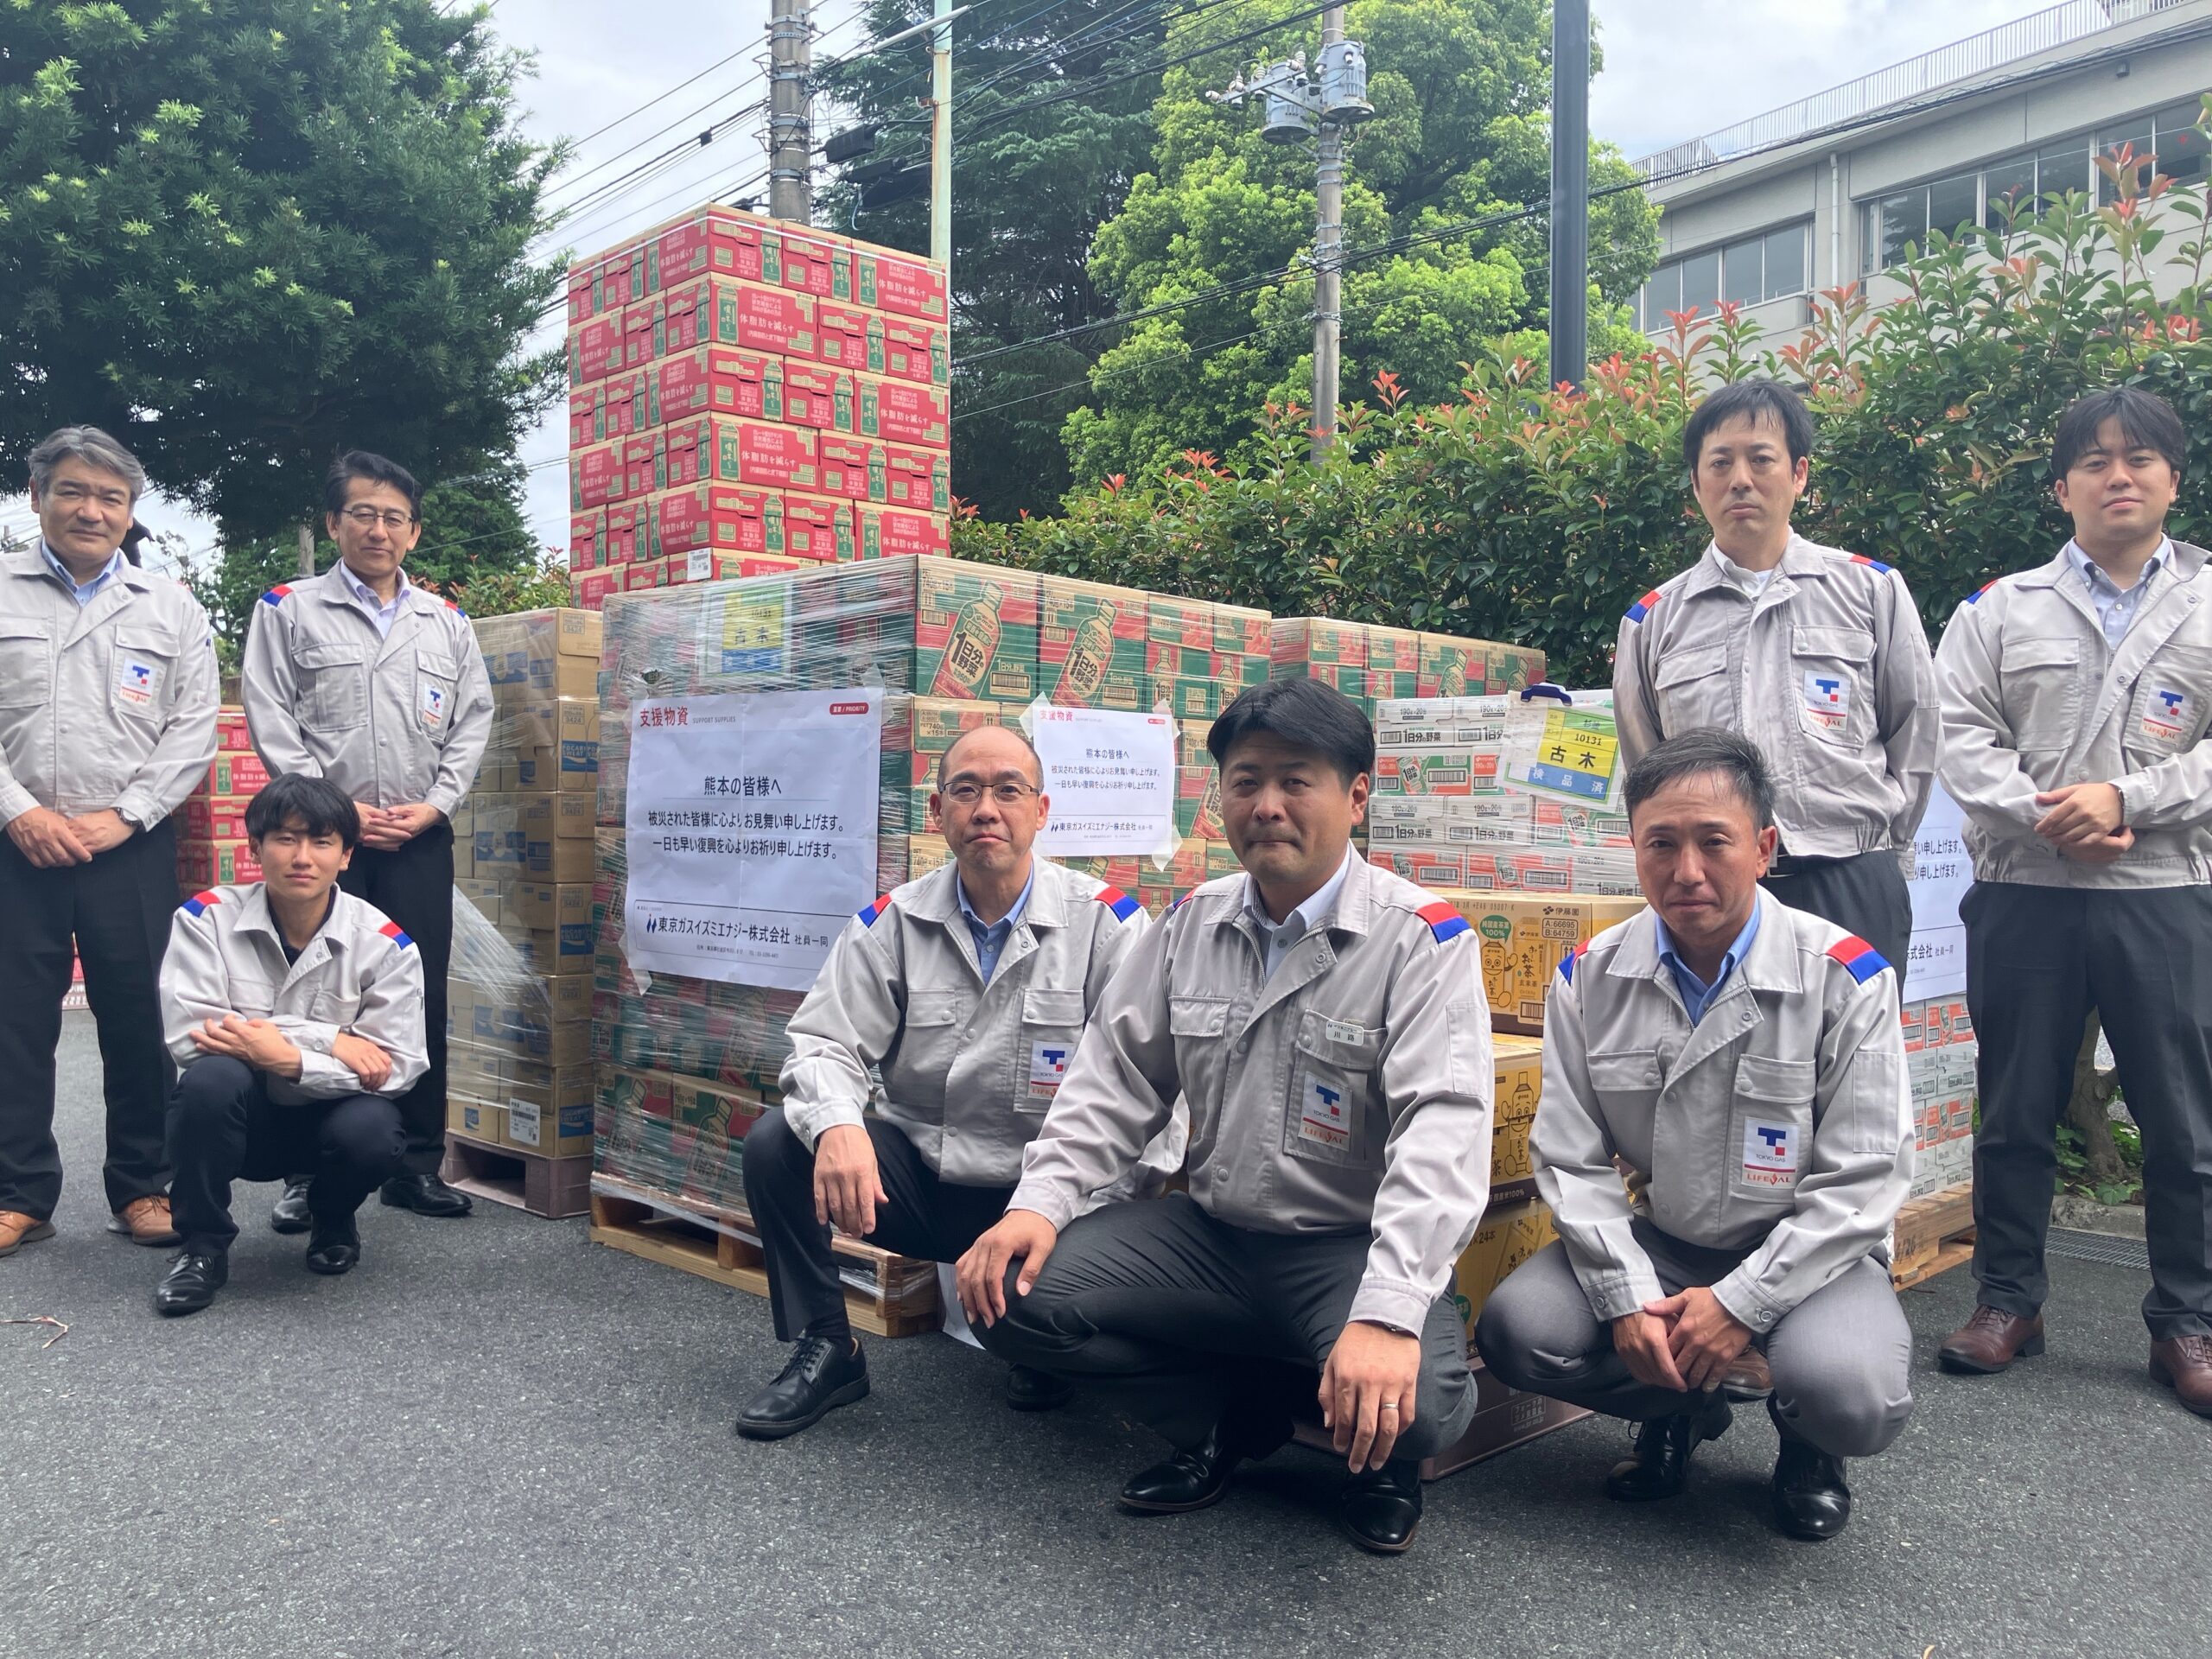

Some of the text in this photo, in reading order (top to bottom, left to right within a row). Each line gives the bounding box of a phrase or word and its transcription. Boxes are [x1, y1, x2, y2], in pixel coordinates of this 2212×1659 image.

[740, 313, 794, 332] 体脂肪を減らす
[880, 408, 928, 425] 体脂肪を減らす
[741, 450, 796, 467] 体脂肪を減らす
[882, 537, 930, 551] 体脂肪を減らす
[957, 654, 979, 677] 野菜
[640, 707, 688, 727] 支援物資
[1403, 728, 1440, 742] 1日分の野菜
[1575, 734, 1602, 746] 10131
[1086, 748, 1129, 760] 熊本の皆様へ
[1550, 746, 1596, 768] 古木
[704, 777, 782, 796] 熊本の皆様へ
[1055, 779, 1157, 790] 一日も早い復興を心よりお祈り申し上げます。
[1533, 767, 1604, 793] 検品済
[648, 810, 843, 831] 被災された皆様に心よりお見舞い申し上げます。
[1059, 822, 1136, 831] 東京ガスイズミエナジー株式会社
[1395, 824, 1433, 839] 1日分の野菜
[1474, 826, 1514, 841] 1日分の野菜
[653, 836, 836, 859] 一日も早い復興を心よりお祈り申し上げます。
[1555, 907, 1580, 916] 伊藤園
[658, 917, 829, 947] 東京ガスイズミエナジー株式会社 社員一同
[1545, 929, 1574, 938] B:64759
[1313, 1109, 1329, 1119] TOKYO
